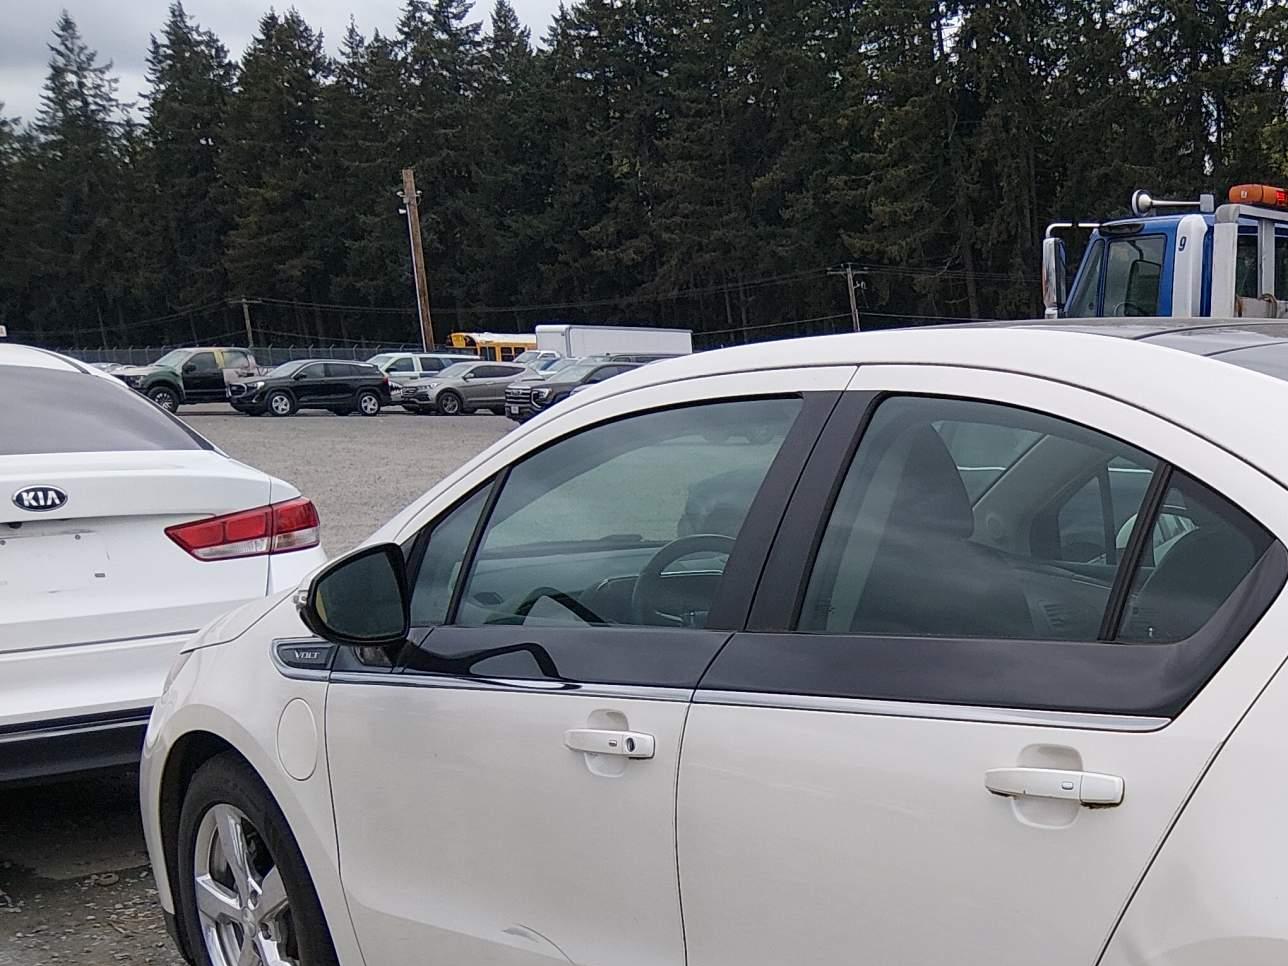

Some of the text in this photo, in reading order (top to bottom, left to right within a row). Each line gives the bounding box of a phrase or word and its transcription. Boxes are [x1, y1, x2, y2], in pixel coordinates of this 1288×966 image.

[1178, 236, 1187, 252] 9
[21, 490, 61, 507] KIA
[294, 649, 321, 660] VOLT
